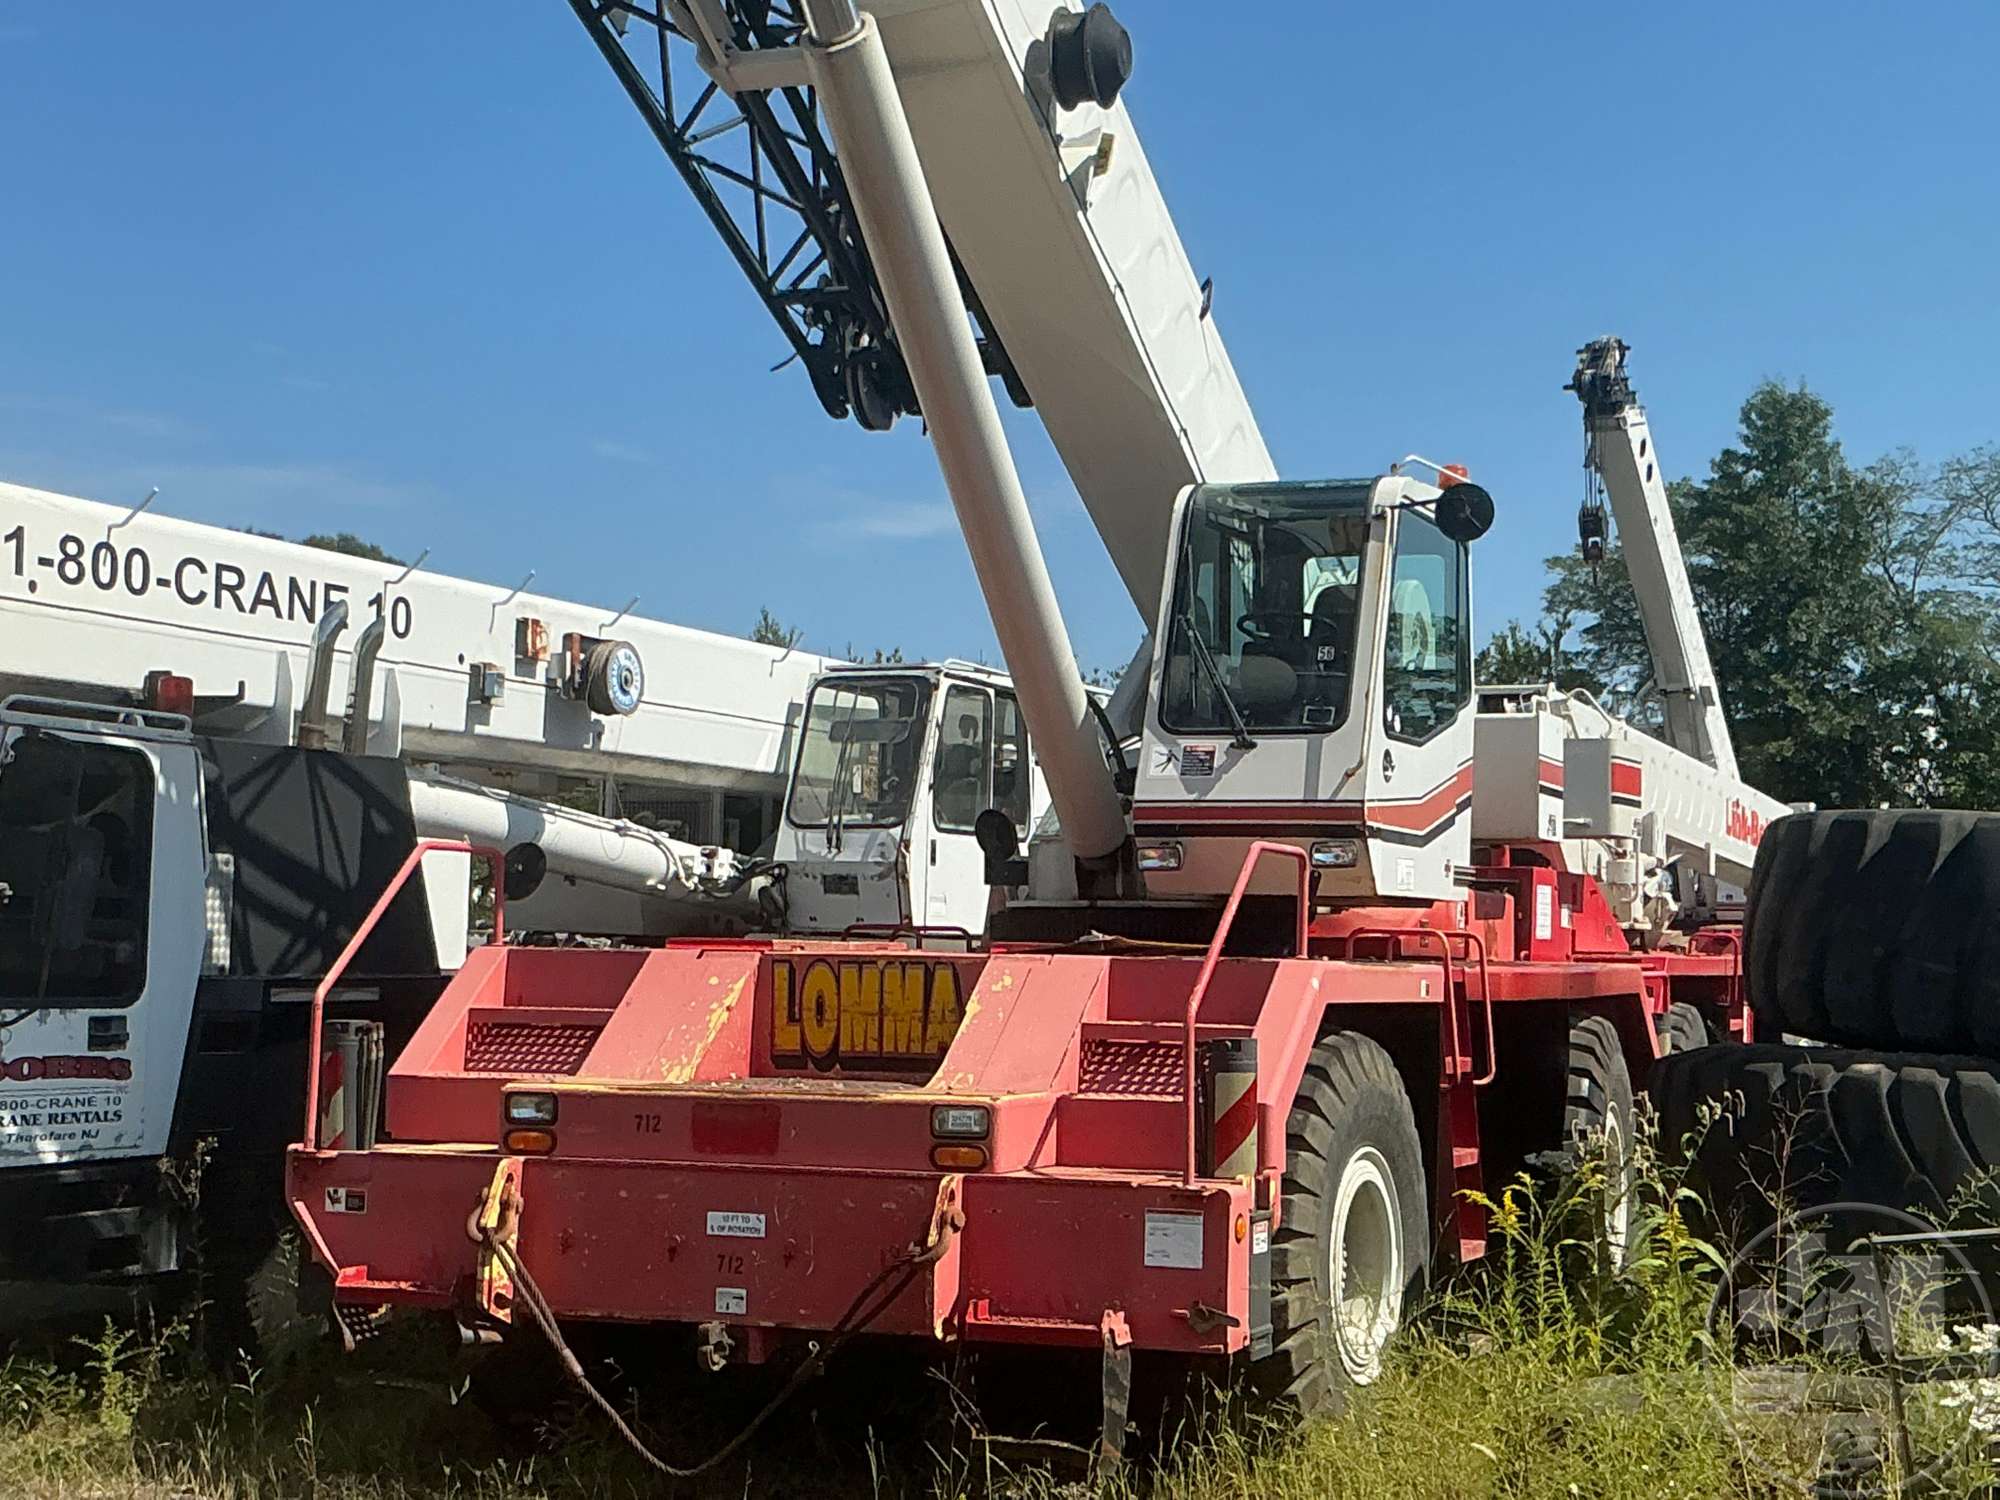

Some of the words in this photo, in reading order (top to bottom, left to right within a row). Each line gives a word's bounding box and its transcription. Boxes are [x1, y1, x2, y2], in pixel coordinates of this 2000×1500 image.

[368, 592, 412, 639] 10
[771, 959, 963, 1068] LOMMA
[0, 1056, 132, 1081] OBBS
[105, 1096, 122, 1106] 10
[47, 1110, 122, 1125] RENTALS
[634, 1114, 662, 1133] 712
[81, 1129, 100, 1139] NJ
[717, 1254, 745, 1275] 712
